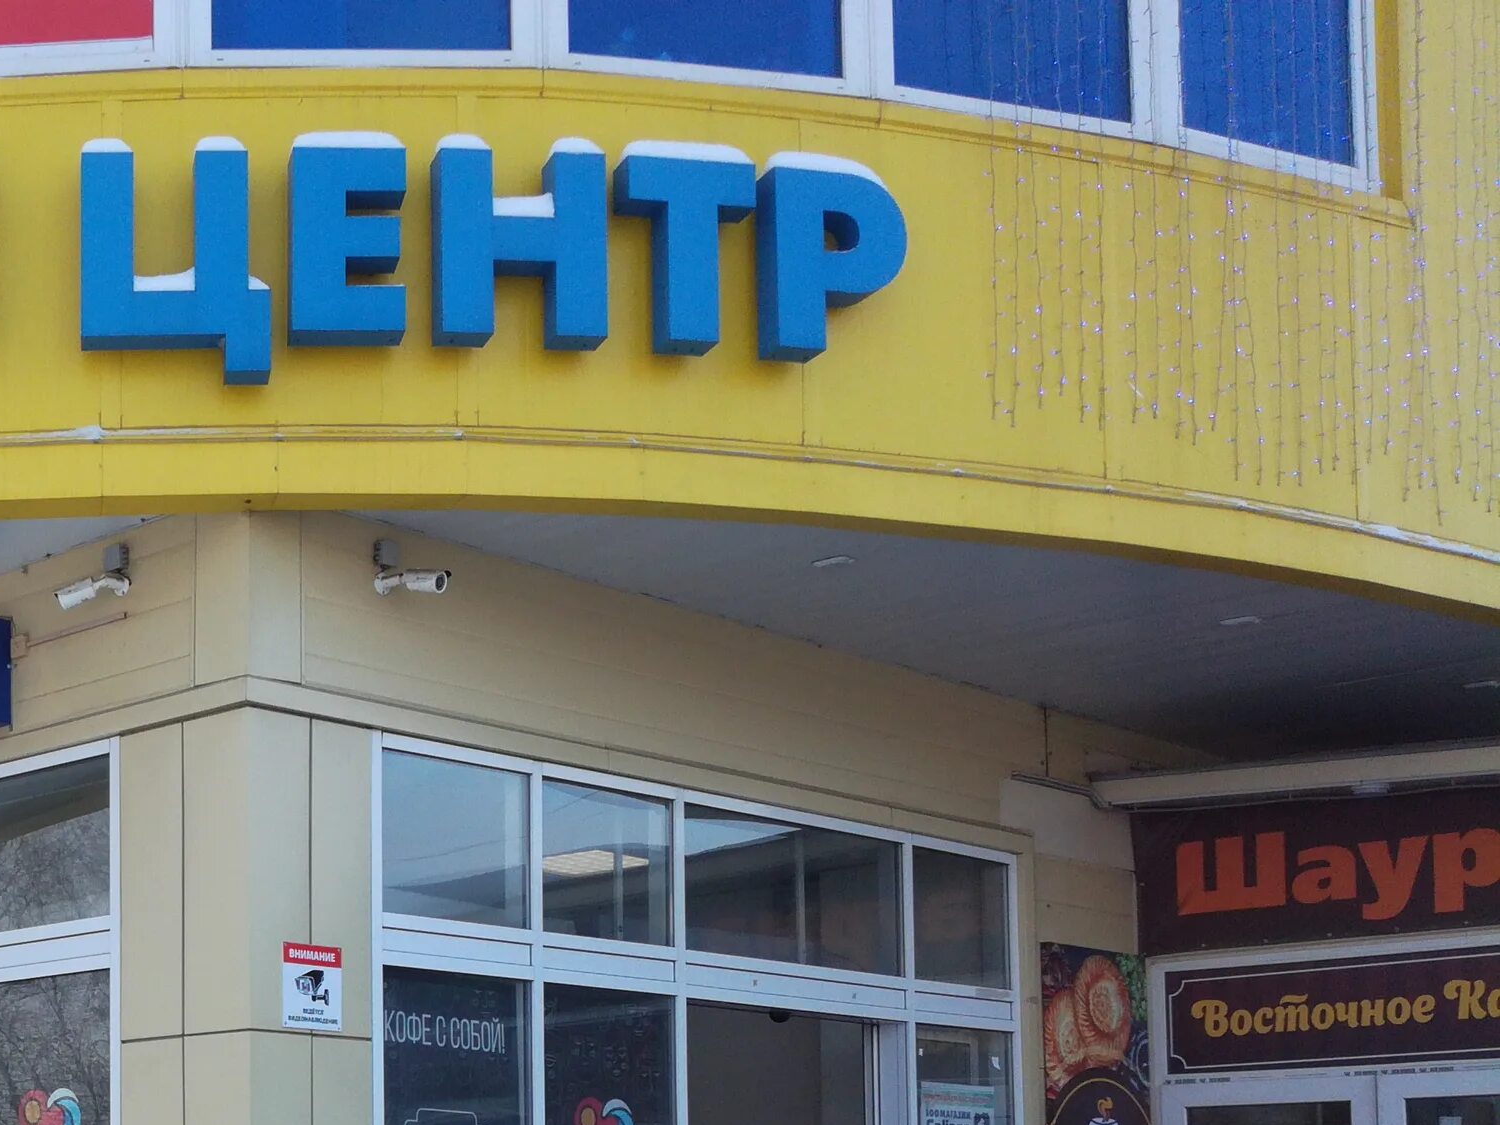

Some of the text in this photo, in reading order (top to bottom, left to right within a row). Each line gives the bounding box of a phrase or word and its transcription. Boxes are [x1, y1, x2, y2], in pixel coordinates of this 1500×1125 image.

[81, 134, 907, 386] ЦЕНТР
[288, 948, 336, 963] ВНИМАНИЕ
[384, 1009, 505, 1054] КОФЕ С СОБОЙ!
[1191, 993, 1436, 1038] Восточное
